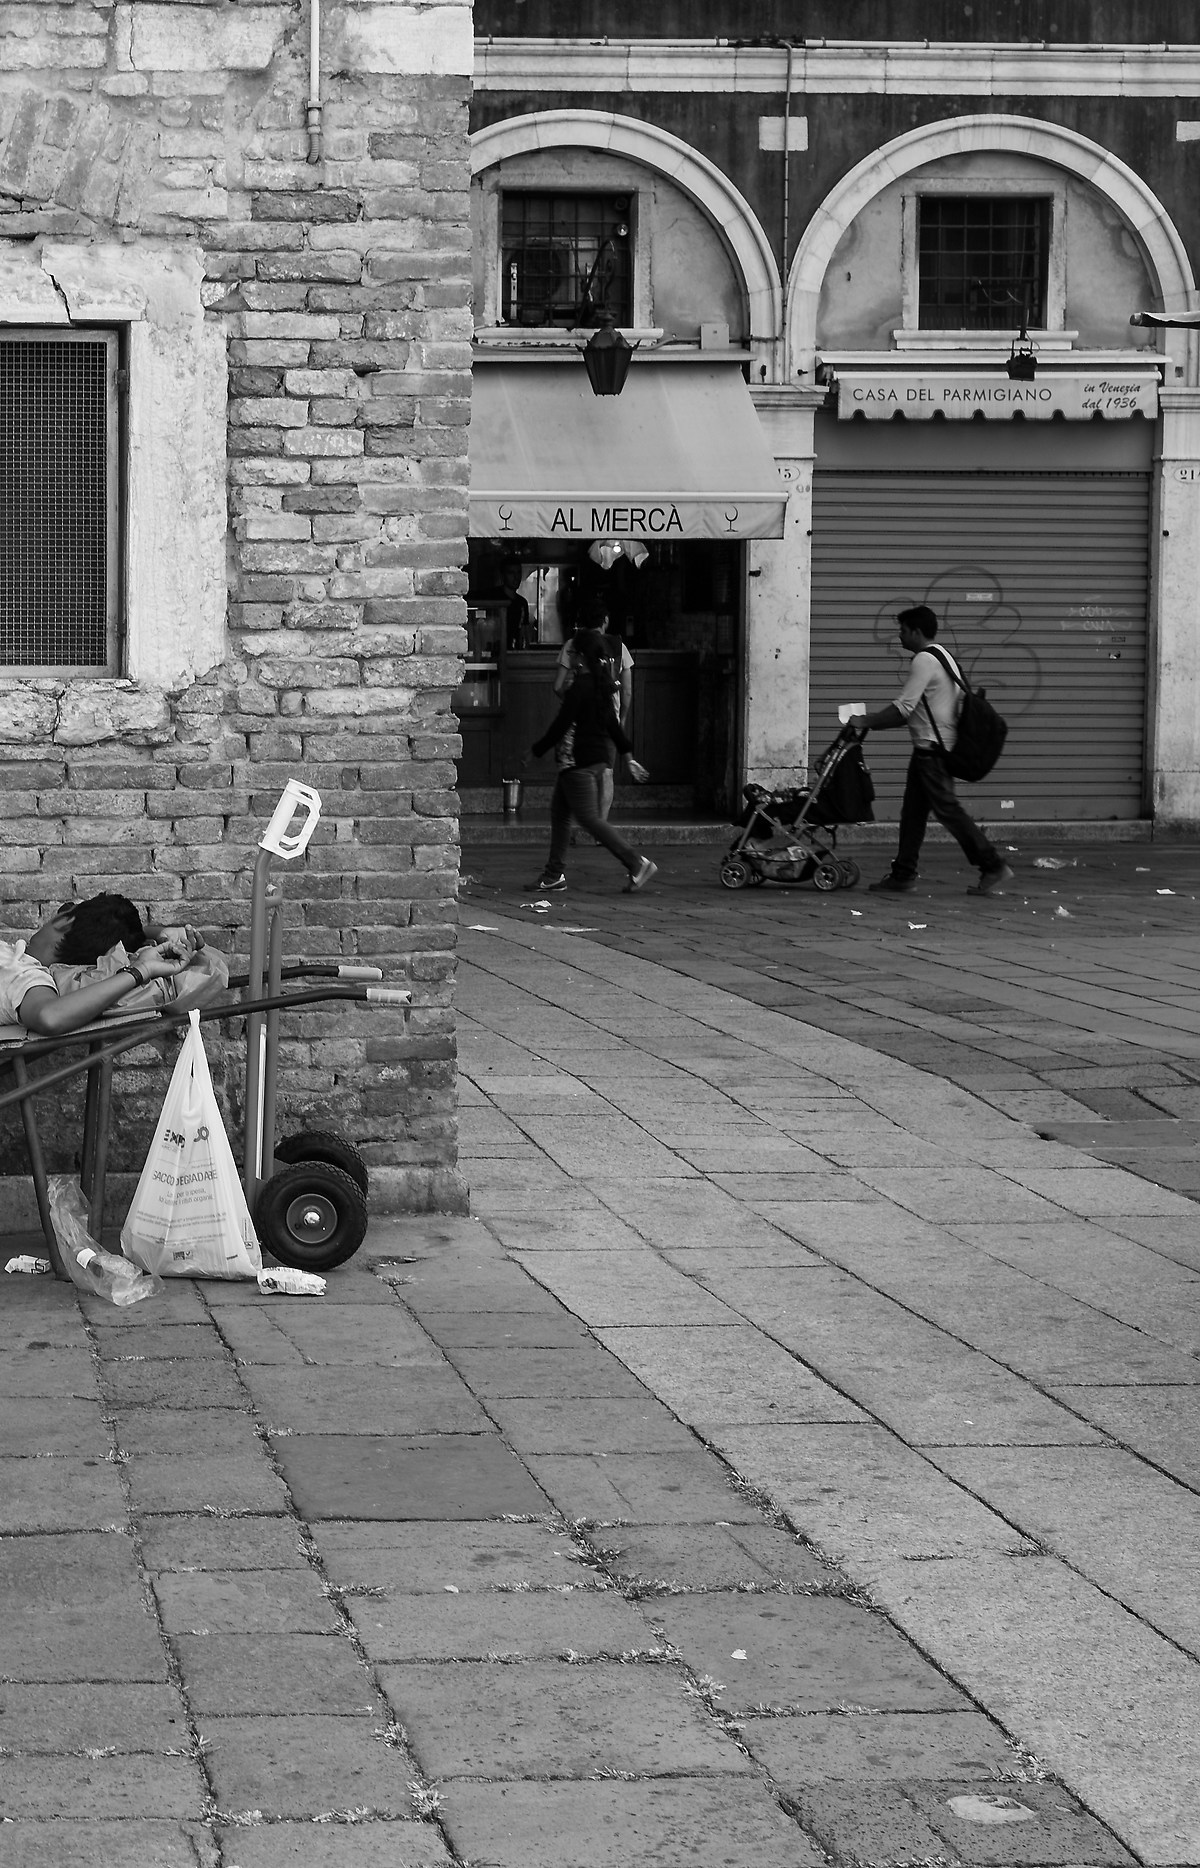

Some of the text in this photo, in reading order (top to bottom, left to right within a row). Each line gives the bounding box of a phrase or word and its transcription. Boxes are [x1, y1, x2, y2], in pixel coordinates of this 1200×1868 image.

[852, 388, 1053, 402] CASA DEL PARMIGIANO
[1083, 381, 1141, 396] in Venezia
[1081, 396, 1137, 409] dal 1936
[1180, 469, 1200, 480] 21
[550, 503, 684, 533] AL MERCÀ
